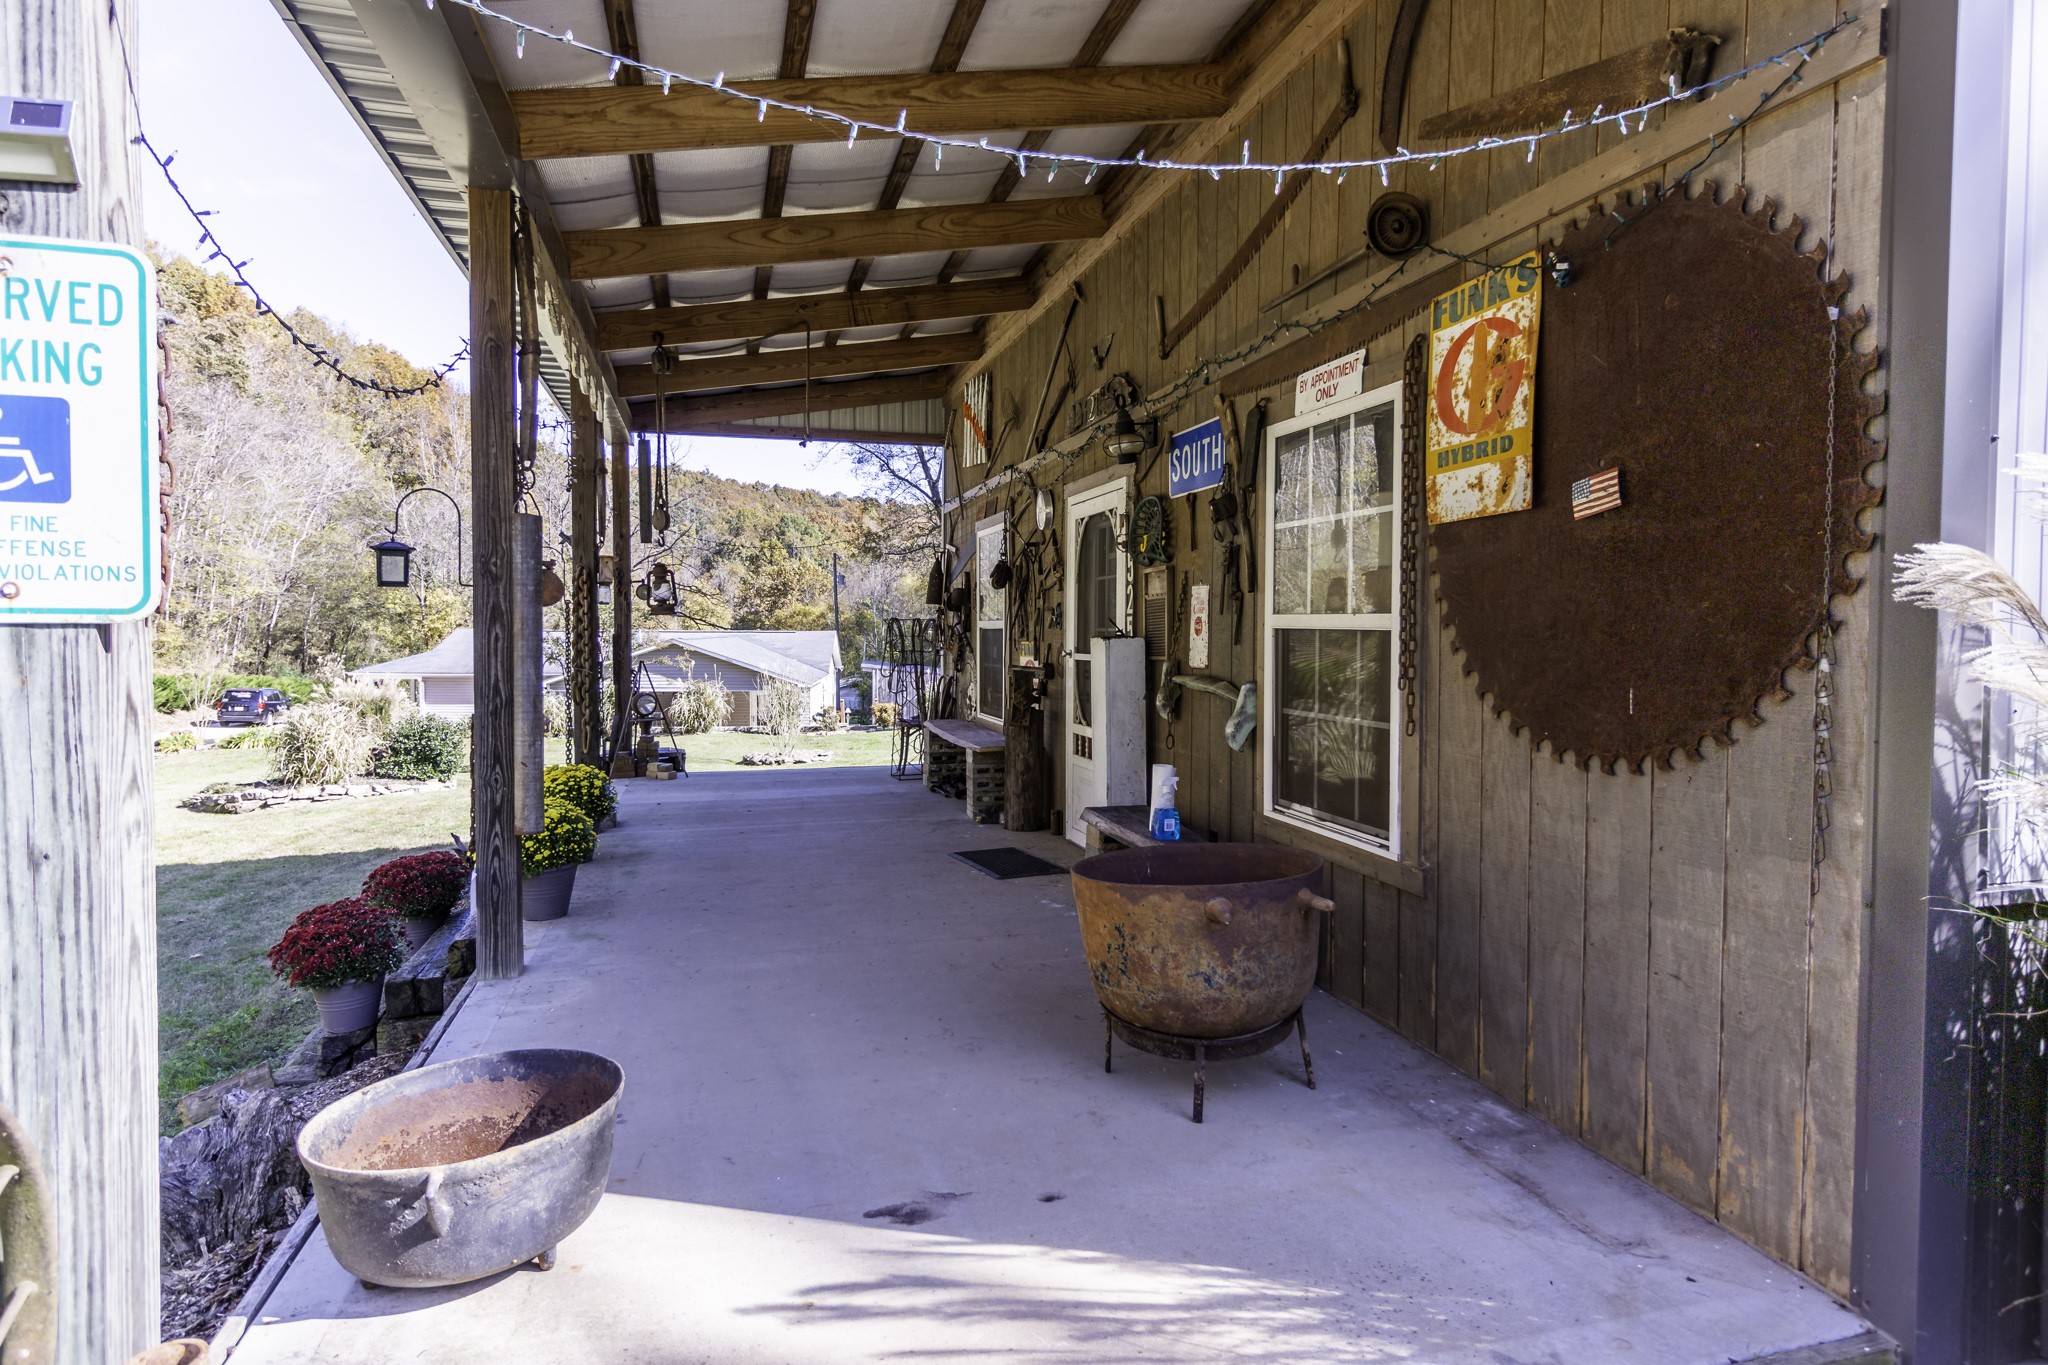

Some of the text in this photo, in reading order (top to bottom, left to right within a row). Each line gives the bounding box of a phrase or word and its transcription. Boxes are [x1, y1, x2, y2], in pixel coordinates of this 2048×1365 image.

[5, 276, 123, 327] RVED
[1433, 257, 1538, 331] FUNK'S
[0, 338, 102, 387] KING
[1300, 358, 1359, 393] BY APPOINTMENT
[1315, 382, 1339, 402] ONLY
[1172, 432, 1221, 482] SOUTH
[1437, 434, 1514, 468] HYBRID
[10, 515, 58, 532] FINE
[0, 563, 136, 582] VIOLATIONS
